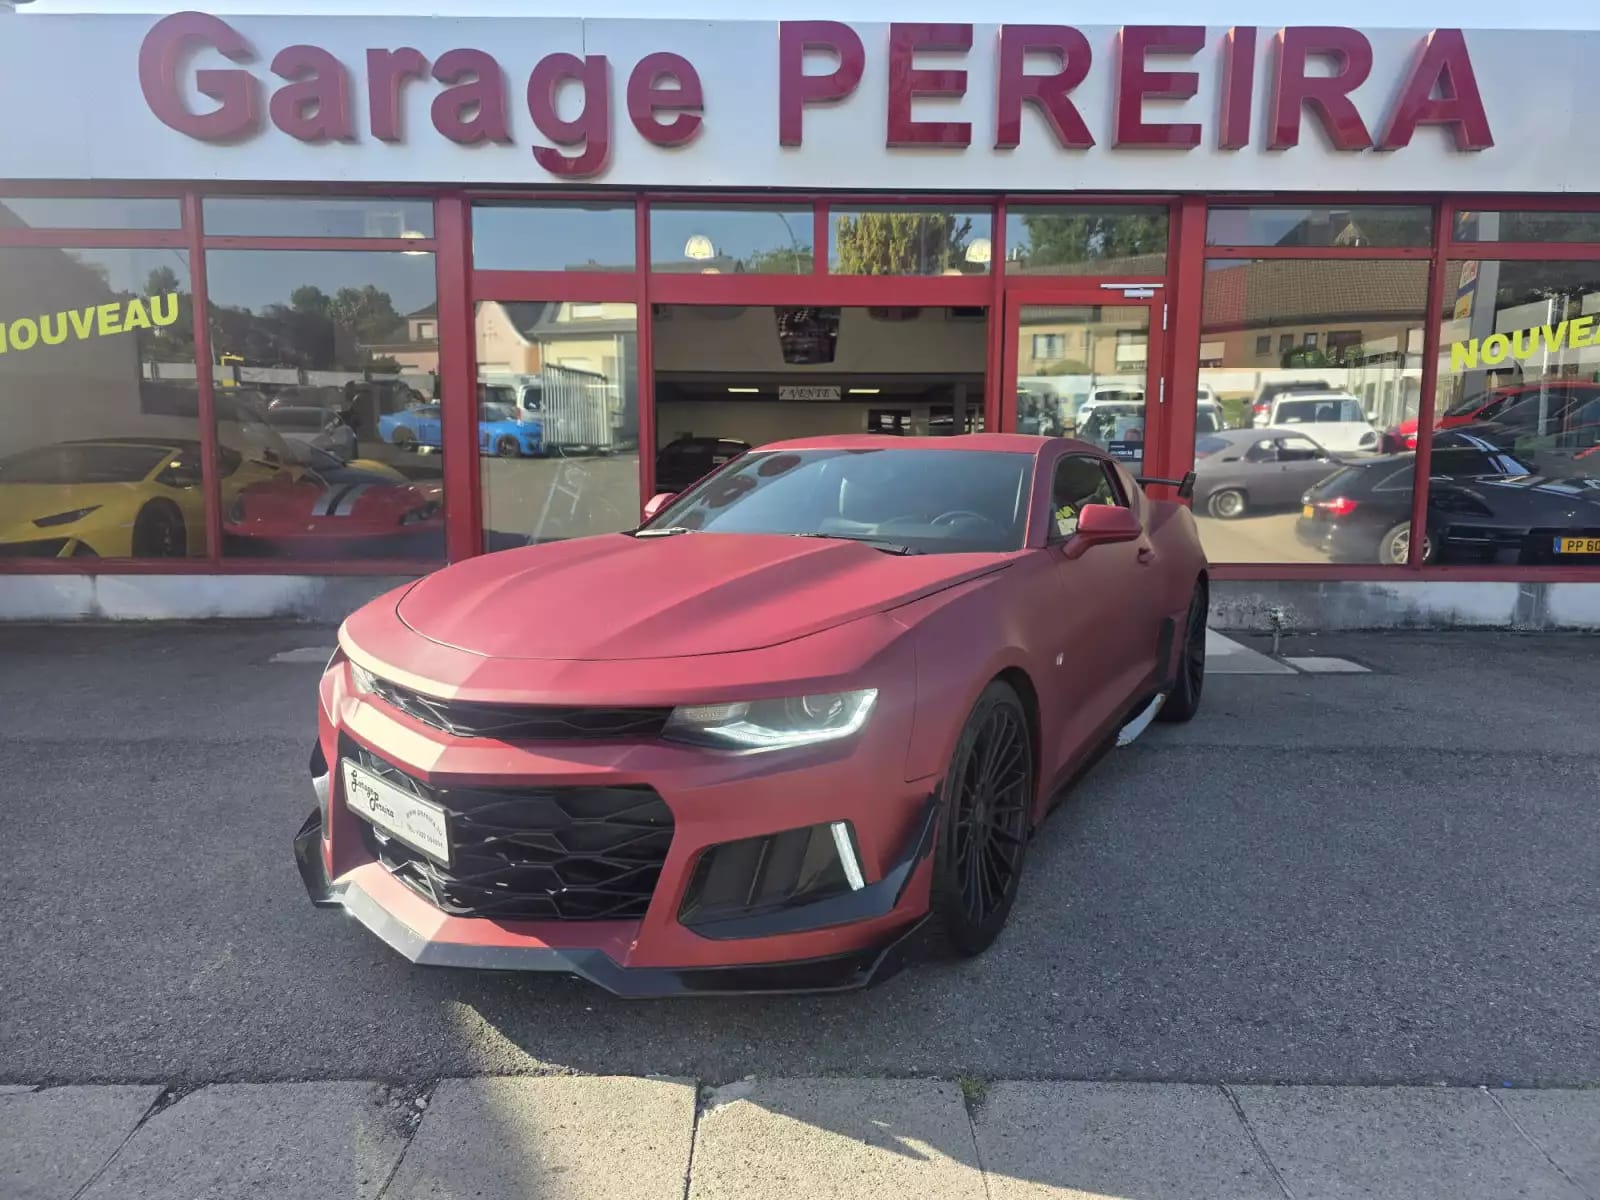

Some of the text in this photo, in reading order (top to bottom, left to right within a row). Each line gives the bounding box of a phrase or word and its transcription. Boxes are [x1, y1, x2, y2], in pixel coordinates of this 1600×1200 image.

[138, 11, 1494, 180] Garage PEREIRA
[0, 292, 179, 353] OUVEAU
[1450, 315, 1600, 373] NOUVE
[1567, 540, 1584, 551] PP
